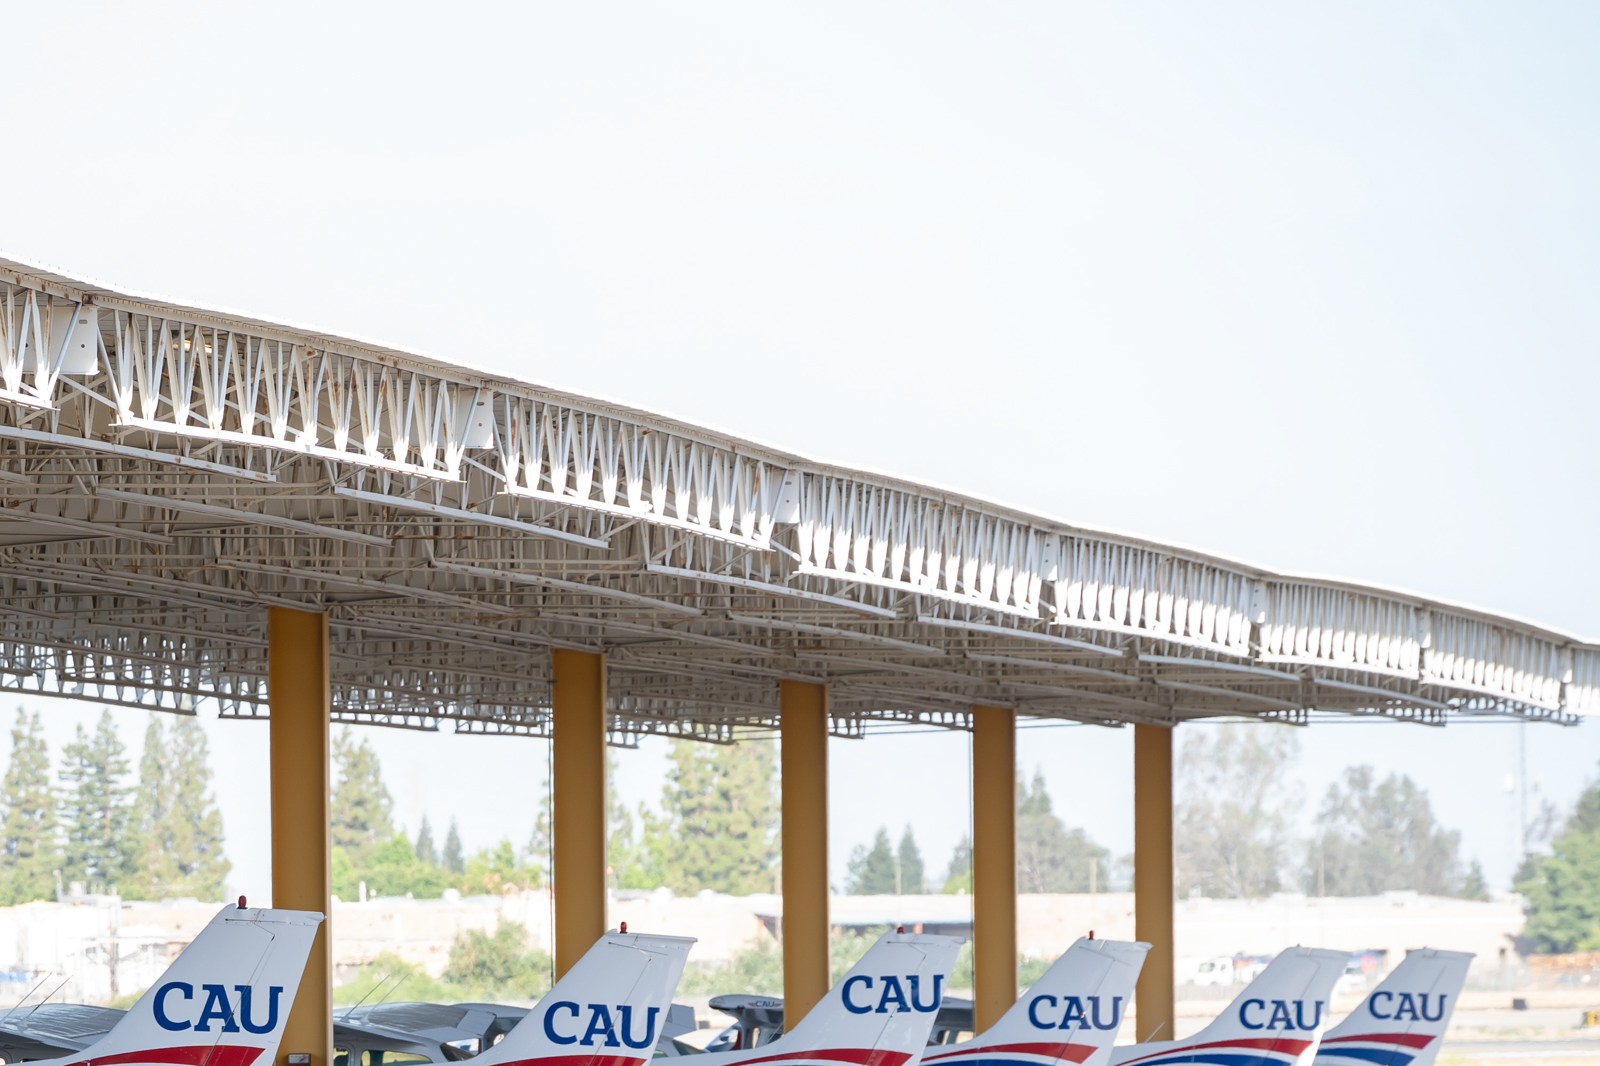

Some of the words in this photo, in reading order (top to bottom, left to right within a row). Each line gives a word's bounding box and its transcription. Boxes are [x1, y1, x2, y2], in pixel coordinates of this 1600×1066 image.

[153, 981, 283, 1034] CAU
[842, 974, 944, 1014] CAU
[1029, 995, 1123, 1030] CAU
[1369, 991, 1447, 1022] CAU
[544, 1001, 660, 1049] CAU
[1239, 999, 1324, 1030] CAU
